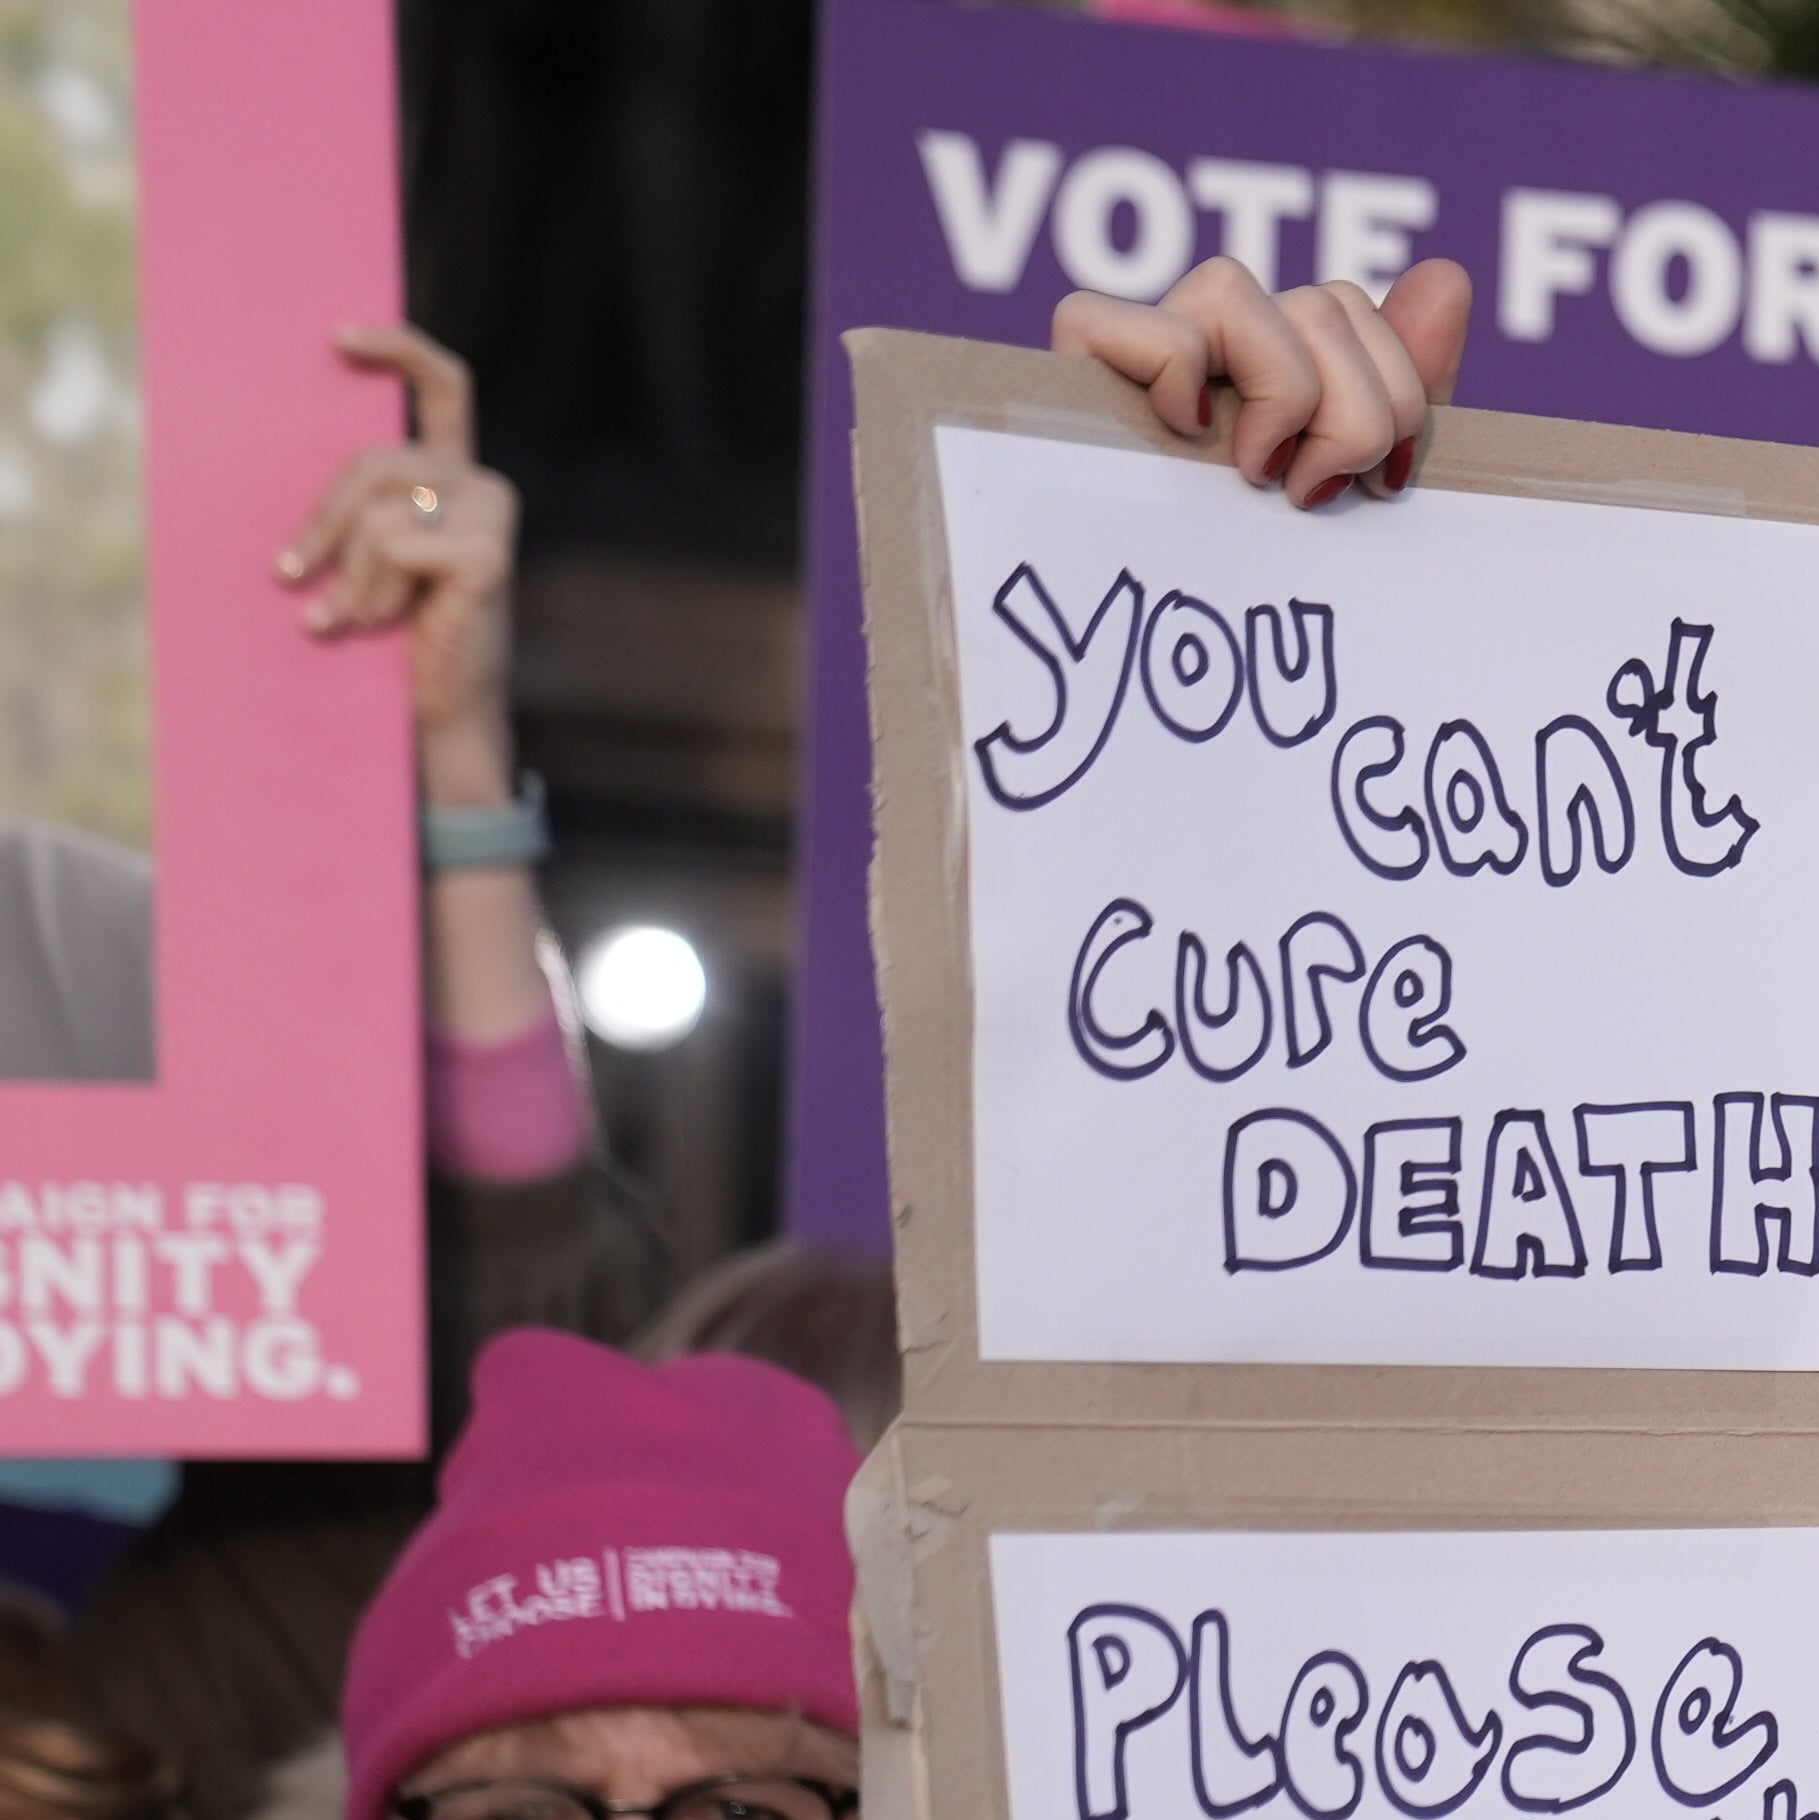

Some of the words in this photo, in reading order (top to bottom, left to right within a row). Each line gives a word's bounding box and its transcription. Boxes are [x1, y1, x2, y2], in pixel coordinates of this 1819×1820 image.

[917, 128, 1438, 310] VOTE
[186, 1180, 326, 1228] FOR
[0, 1228, 324, 1315] NITY
